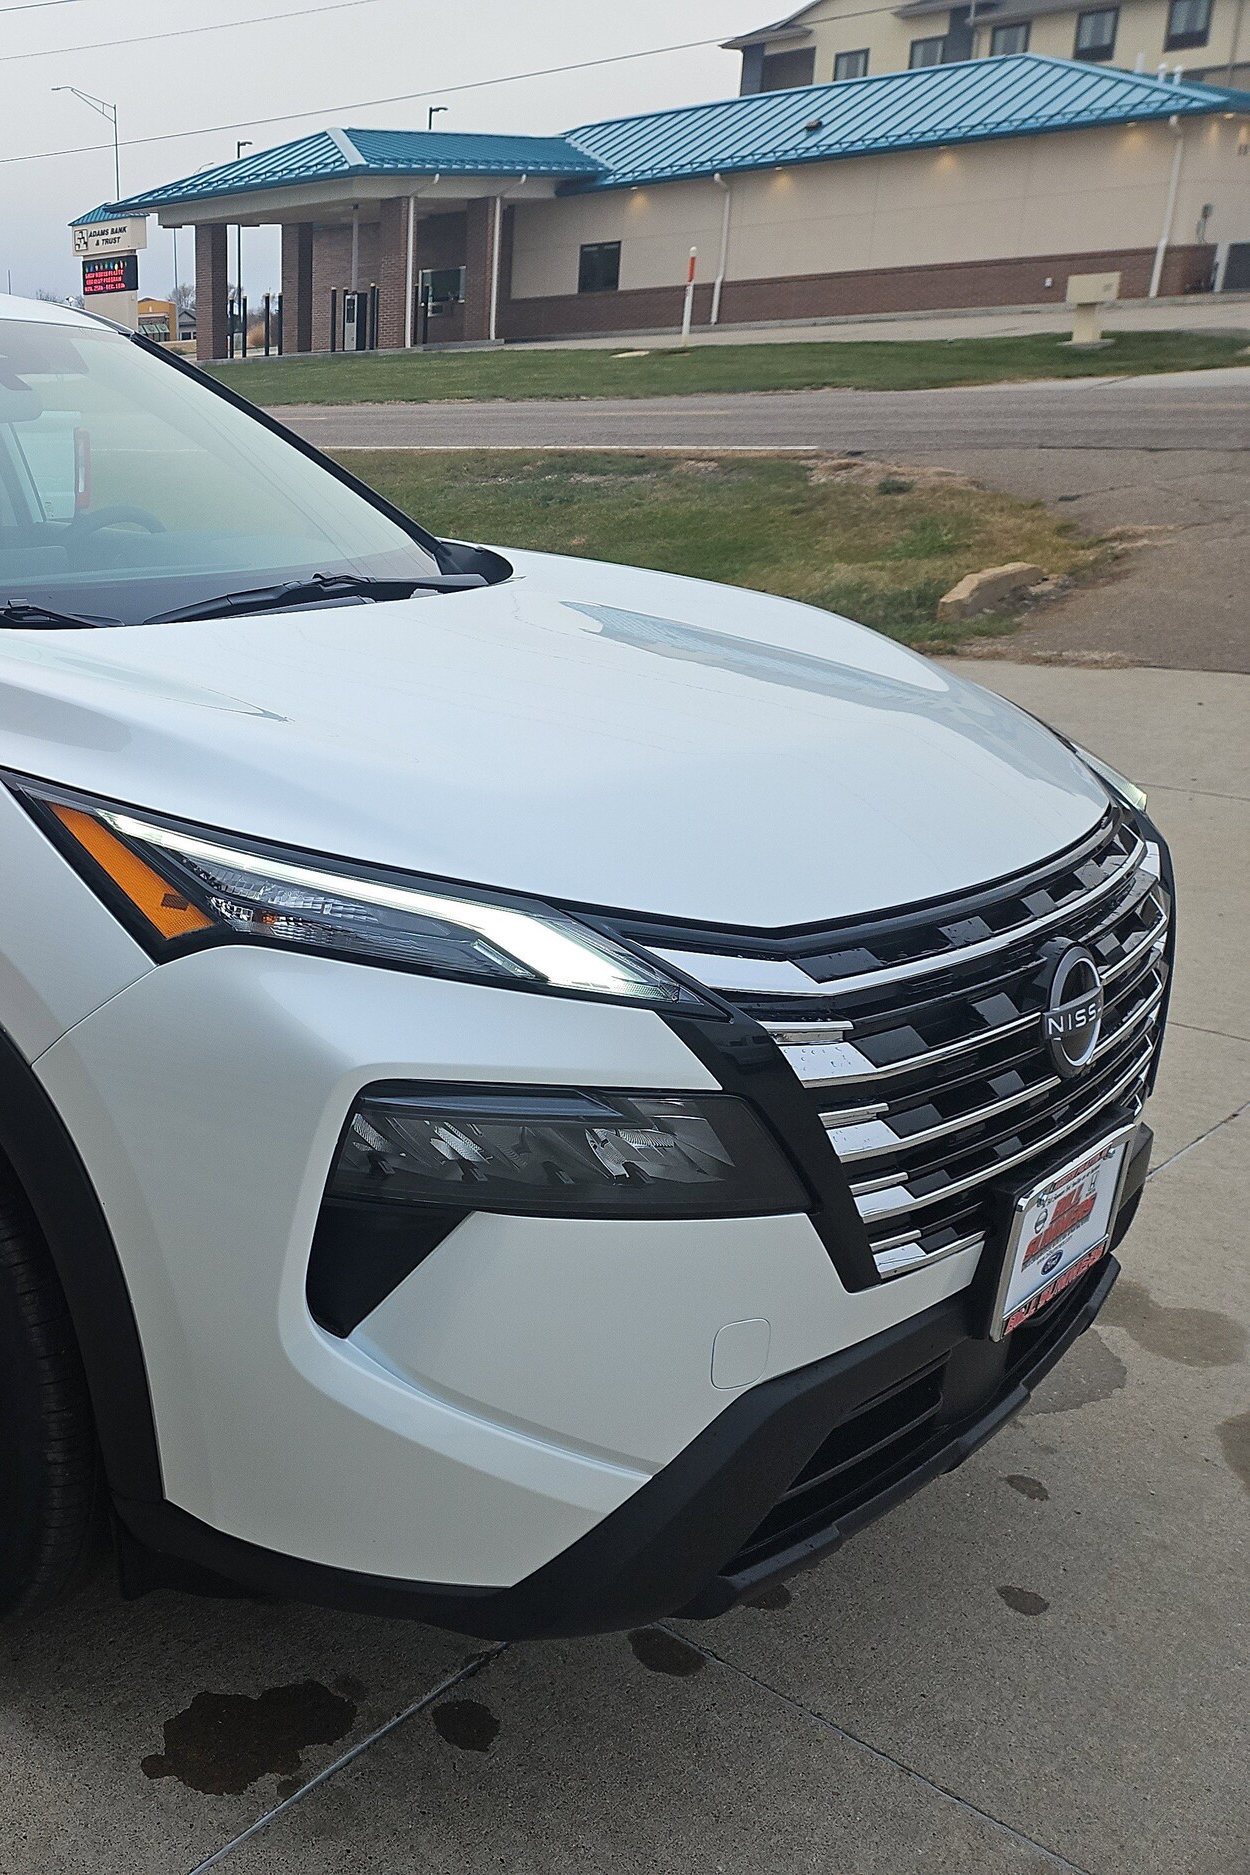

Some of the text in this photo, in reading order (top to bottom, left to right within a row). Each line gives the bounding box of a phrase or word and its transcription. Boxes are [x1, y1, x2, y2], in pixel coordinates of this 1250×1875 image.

[89, 226, 127, 238] ADAMS BANK
[102, 236, 121, 245] TRUST
